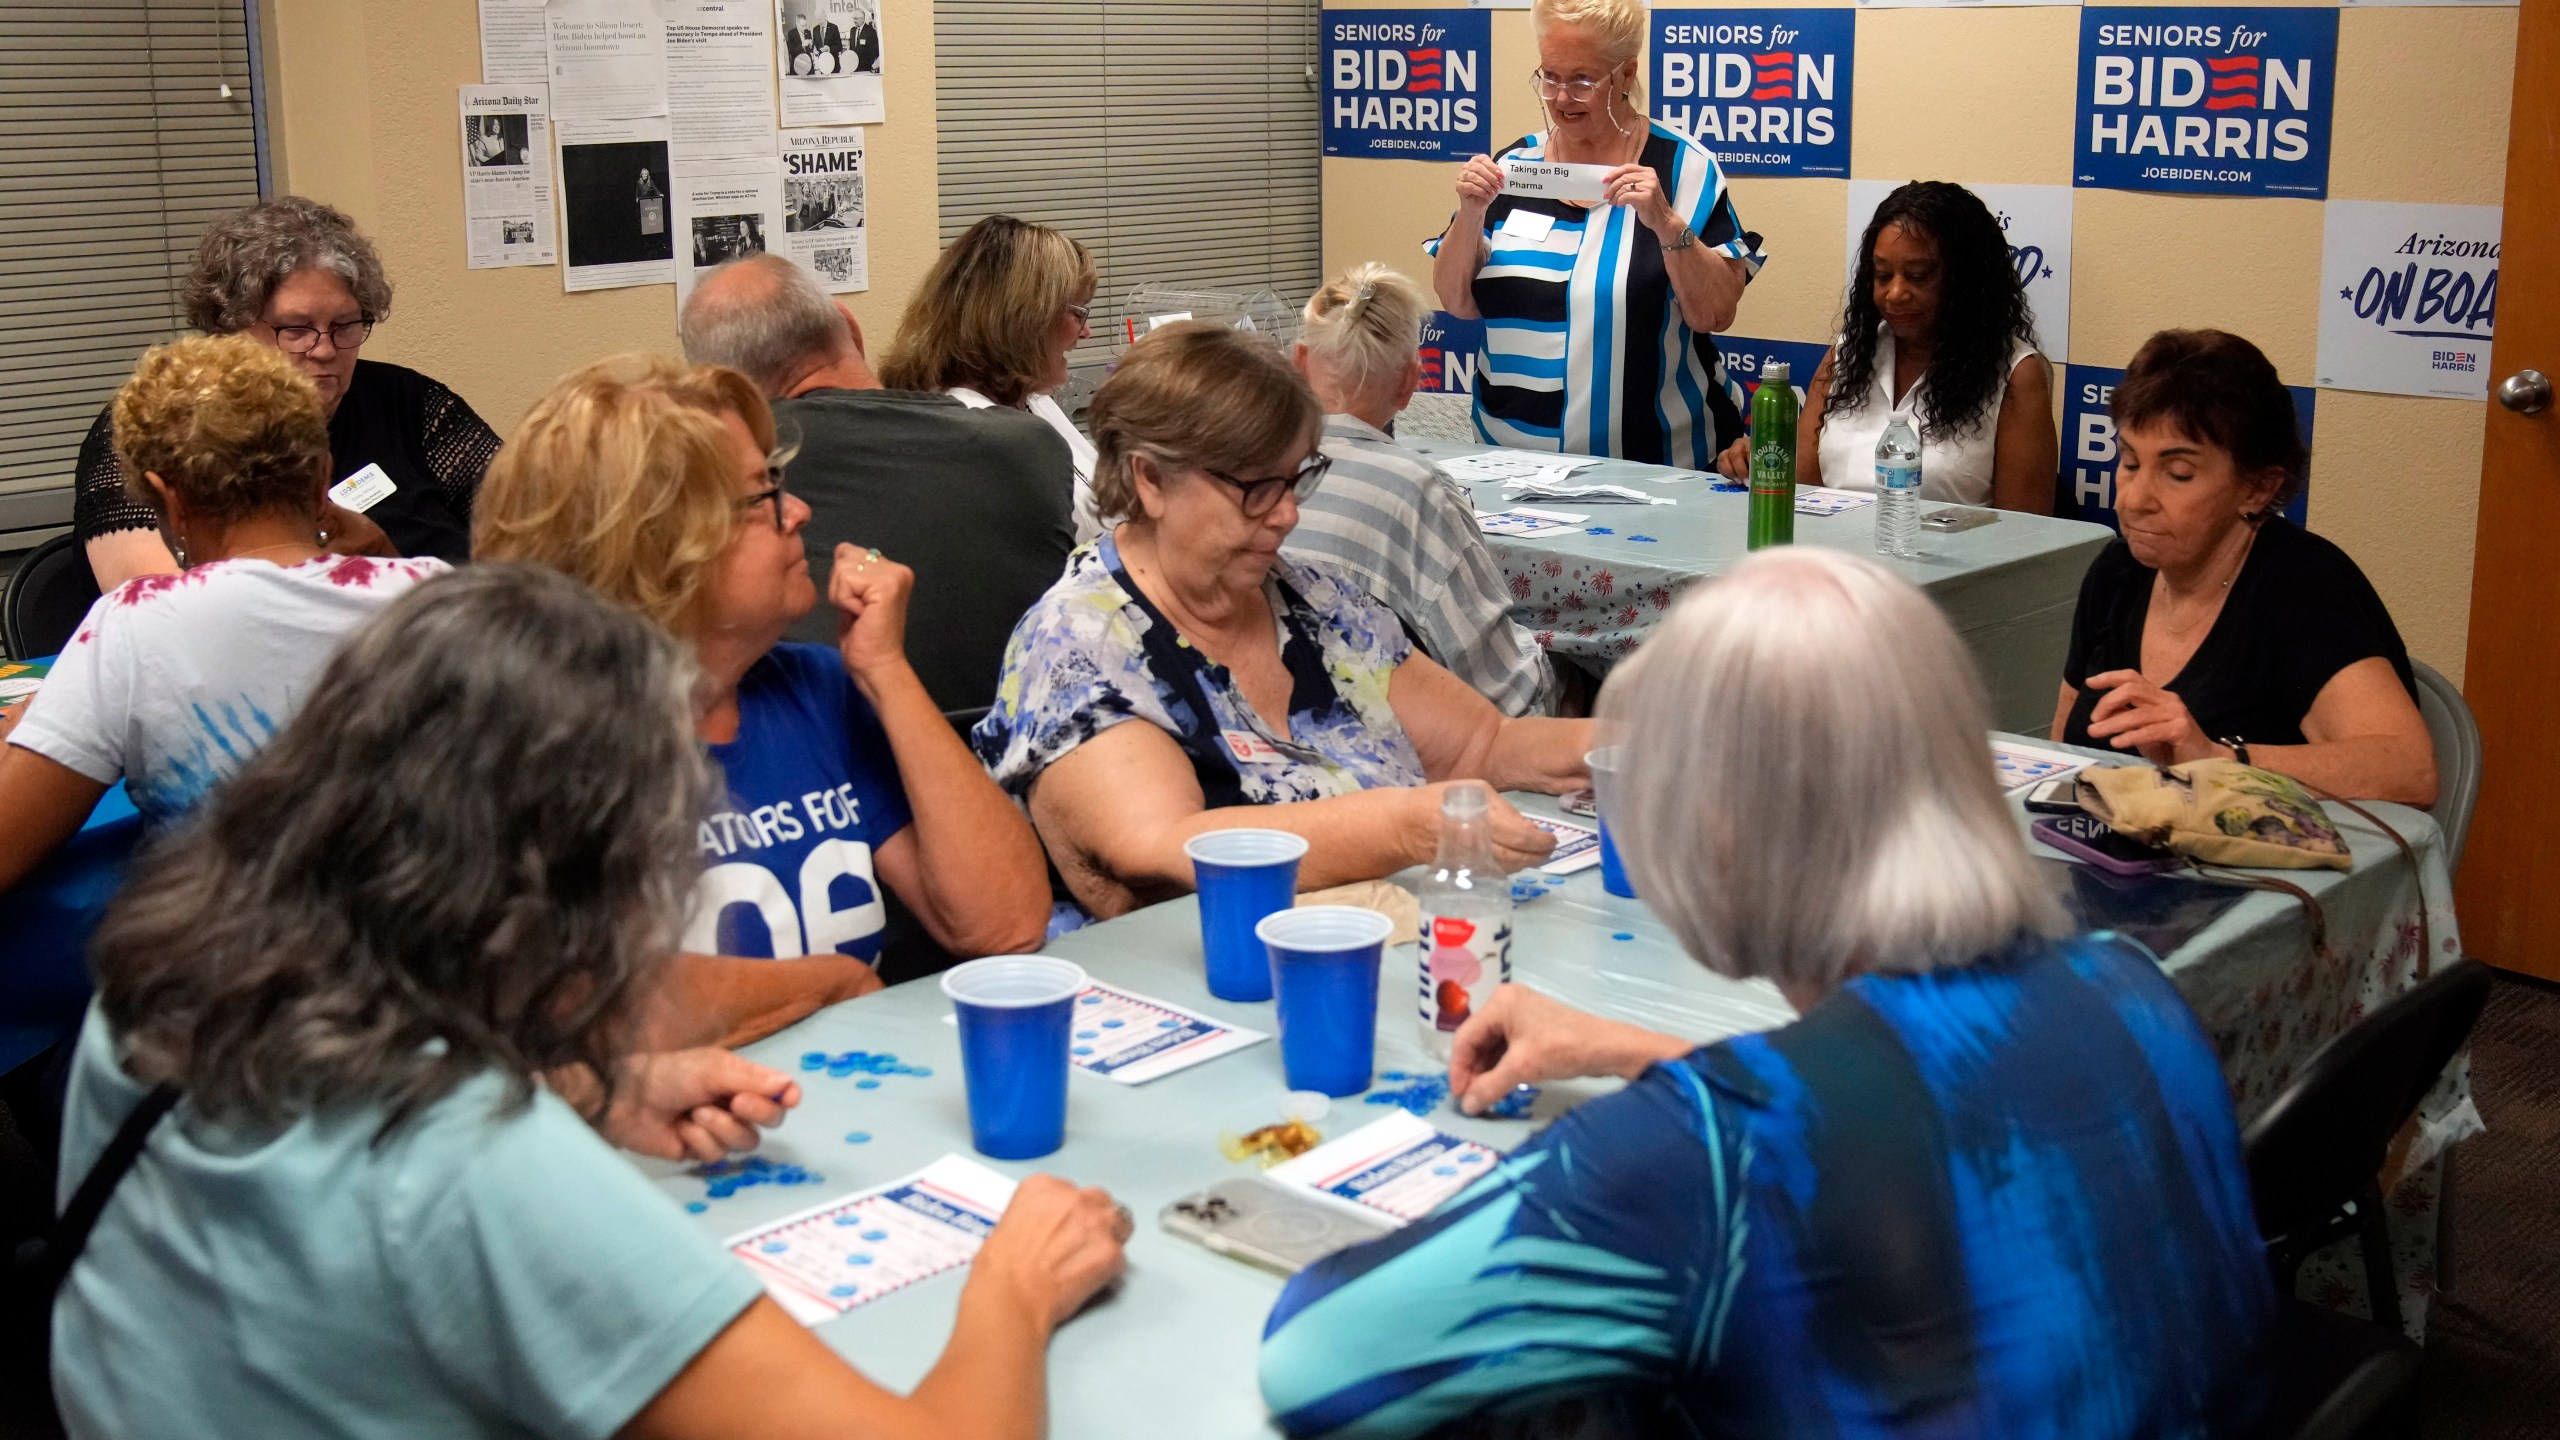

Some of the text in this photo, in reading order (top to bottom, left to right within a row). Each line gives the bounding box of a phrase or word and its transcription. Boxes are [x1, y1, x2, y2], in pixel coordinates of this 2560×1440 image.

[553, 22, 585, 30] Welcome
[1334, 23, 1445, 46] SENIORS for
[594, 32, 616, 41] helped
[1664, 24, 1798, 50] SENIORS for
[2098, 25, 2267, 54] SENIORS for
[1333, 48, 1476, 92] BIDEN
[1663, 52, 1834, 100] BIDEN
[2094, 55, 2311, 111] BIDEN
[472, 95, 539, 106] Arizona Daily Star
[1334, 96, 1478, 132] HARRIS
[1662, 104, 1835, 145] HARRIS
[790, 135, 856, 146] ARIZONA REPUBLIC
[1369, 139, 1441, 150] JOEBIDEN.COM
[2092, 113, 2308, 162] HARRIS
[1711, 152, 1791, 164] EBIDEN.COM
[1511, 165, 1537, 175] Taking
[1554, 168, 1569, 177] Big
[2142, 167, 2251, 182] JOEBIDEN.COM
[1510, 181, 1543, 190] Pharma
[2394, 232, 2500, 259] Arizona
[2354, 262, 2418, 326] ON
[1420, 324, 1445, 345] for
[2433, 351, 2476, 363] BIDEN
[2432, 361, 2475, 372] HARRIS
[1754, 445, 1790, 463] MOUNTAIN
[356, 471, 375, 485] DEMS
[1757, 471, 1786, 479] VALLEY
[696, 801, 804, 856] ATORS
